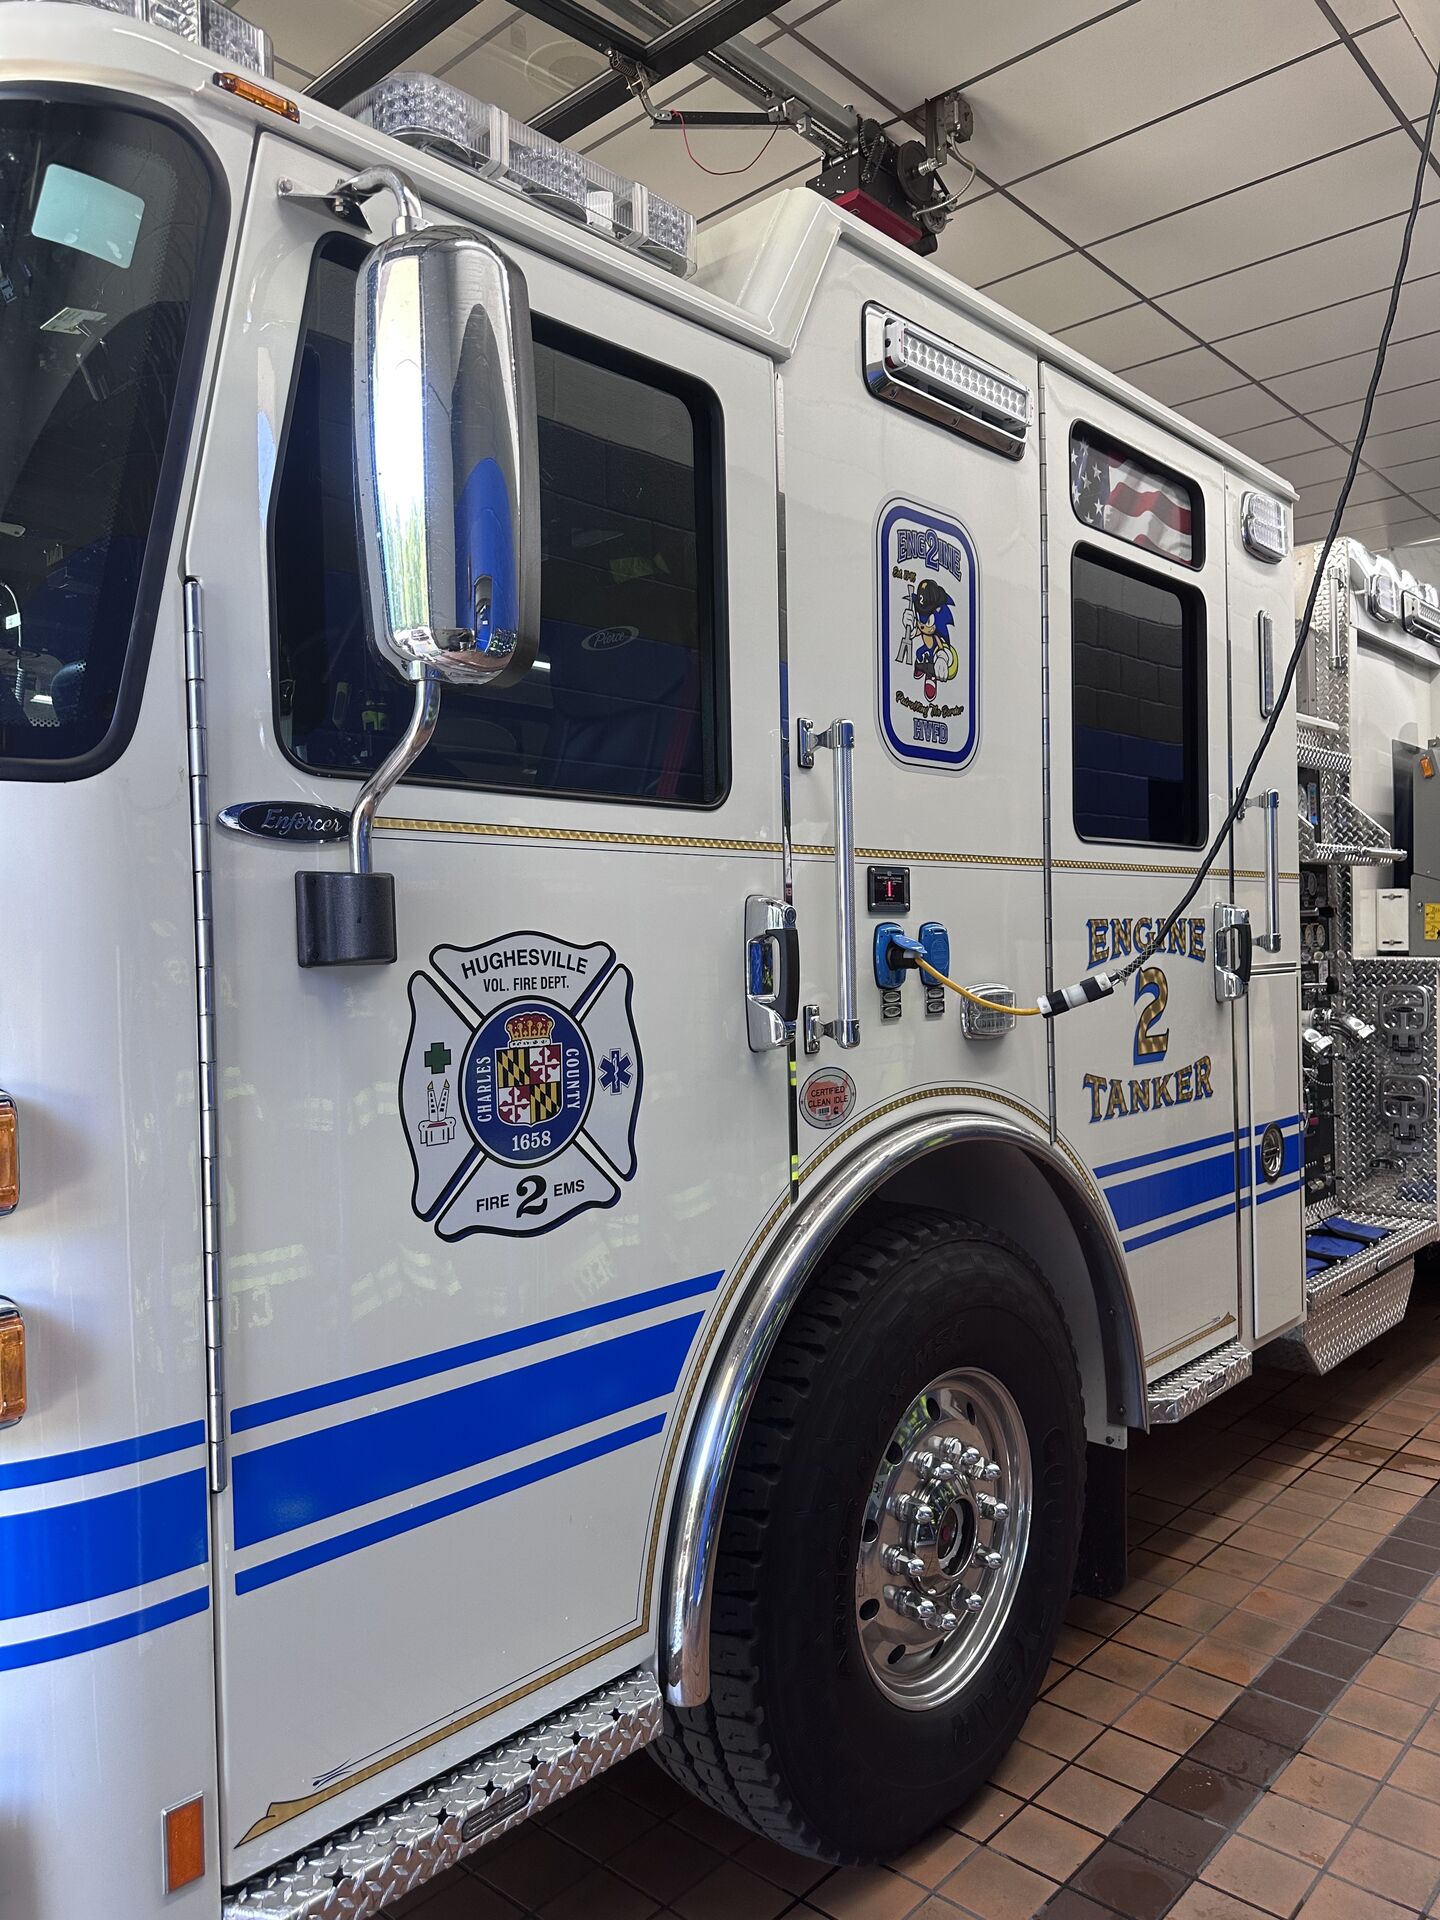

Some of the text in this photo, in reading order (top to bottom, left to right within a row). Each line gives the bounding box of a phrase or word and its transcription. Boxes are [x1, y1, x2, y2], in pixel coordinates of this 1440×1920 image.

[913, 718, 949, 744] HVFD
[261, 808, 343, 835] Enforcer
[1086, 917, 1207, 970] ENGINE
[461, 948, 588, 979] HUGHESVILLE
[483, 975, 569, 993] VOL. FIRE DEPT.
[1133, 967, 1170, 1066] 2
[476, 1056, 492, 1122] CHARLES
[565, 1048, 580, 1109] COUNTY
[811, 1085, 845, 1097] CERTIFIED
[1082, 1055, 1214, 1124] TANKER
[808, 1095, 848, 1108] CLEAN IDLE
[512, 1130, 552, 1151] 1658
[476, 1174, 585, 1218] FIRE 2 EMS
